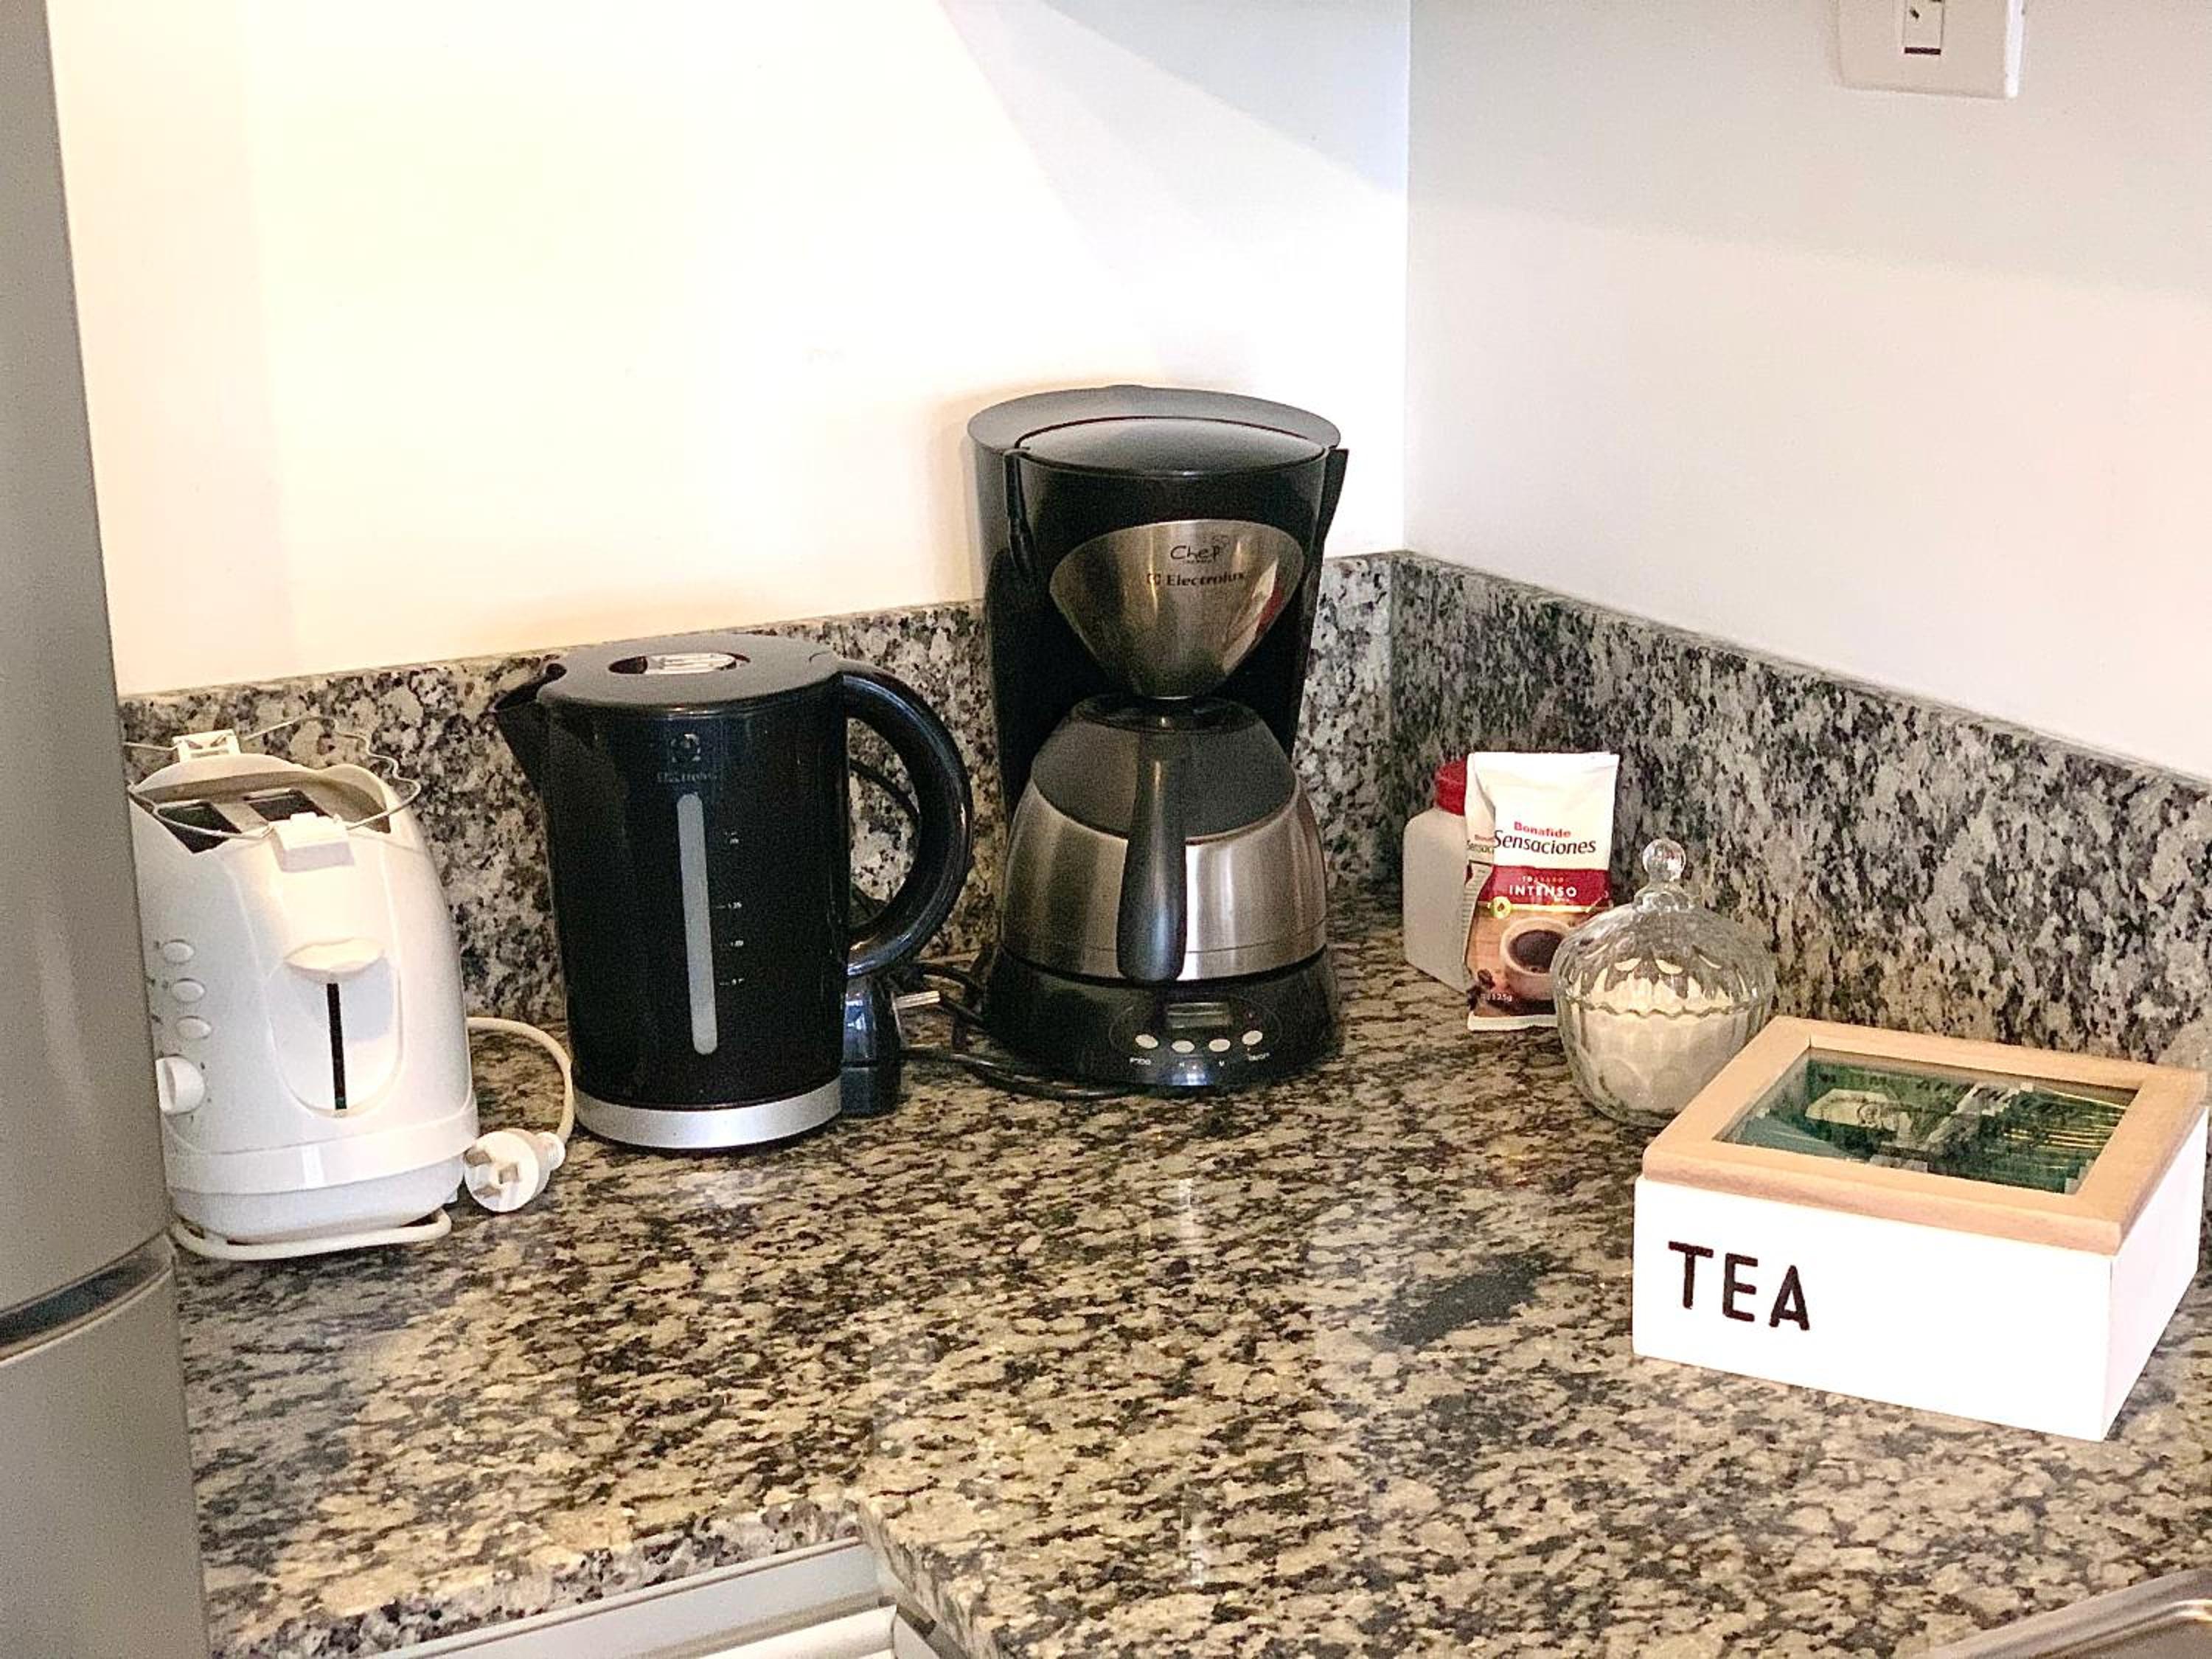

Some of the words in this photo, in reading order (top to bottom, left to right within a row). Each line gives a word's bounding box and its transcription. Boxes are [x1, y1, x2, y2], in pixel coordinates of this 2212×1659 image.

[1166, 571, 1245, 586] Electrolux
[1514, 821, 1572, 838] Bonafide
[1494, 830, 1596, 855] Sensaciones
[1509, 884, 1577, 897] INTENSO
[1668, 1240, 1810, 1331] TEA
